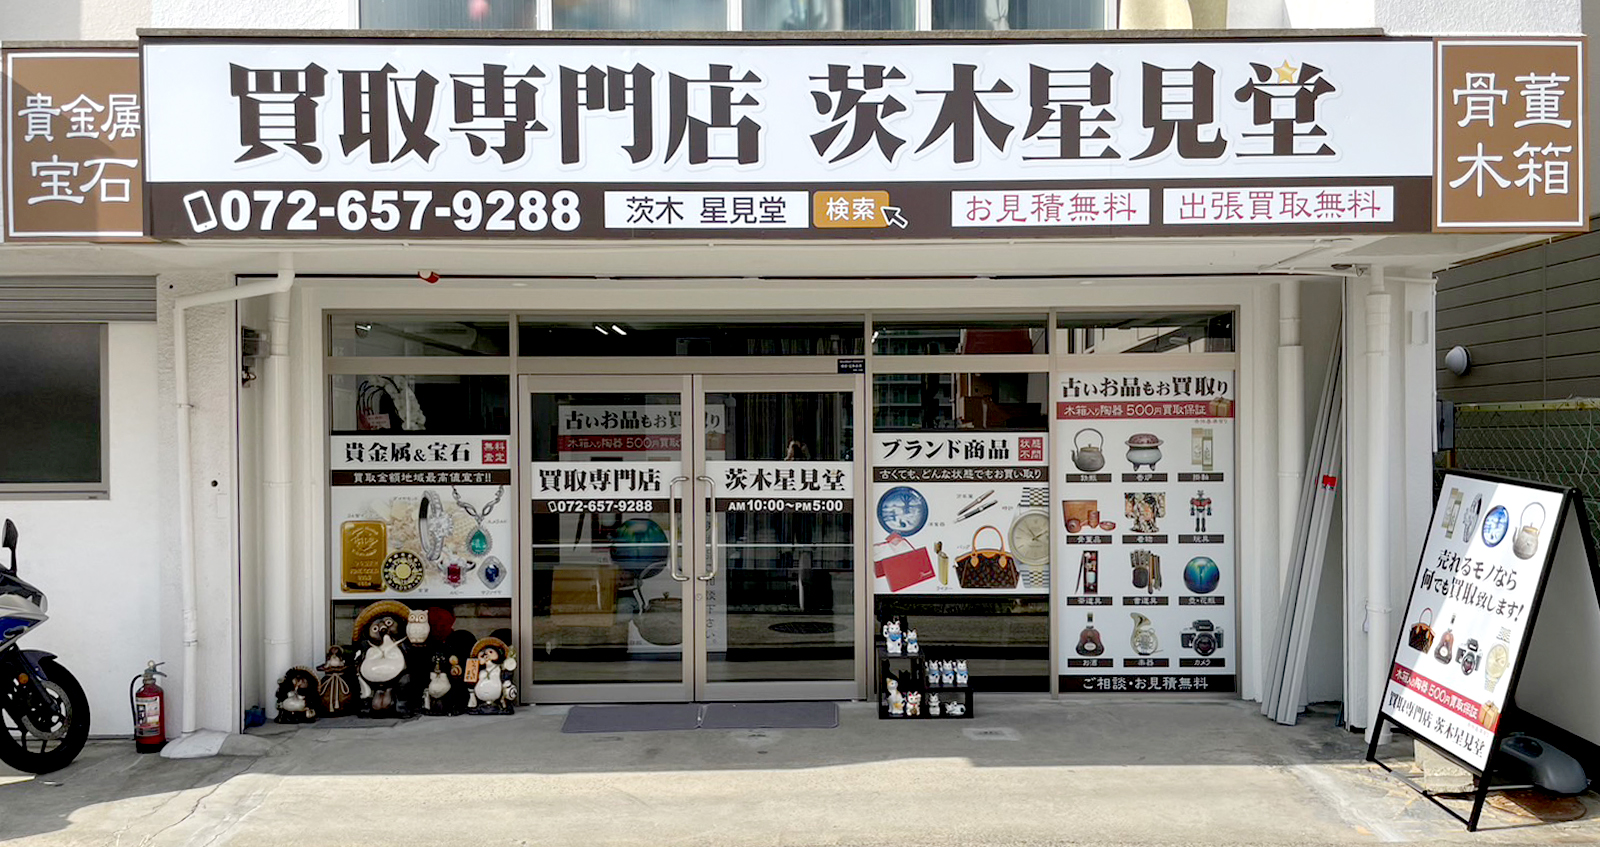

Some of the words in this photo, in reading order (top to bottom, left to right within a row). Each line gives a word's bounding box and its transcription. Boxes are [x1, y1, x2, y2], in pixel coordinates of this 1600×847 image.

[229, 62, 764, 166] 買取専門店
[808, 60, 1336, 163] 茨木星見堂
[1452, 71, 1573, 129] 骨董
[17, 91, 141, 142] 貴金属
[27, 153, 139, 206] 宝石
[1448, 141, 1574, 198] 木箱
[220, 191, 581, 233] 072-657-9288
[626, 196, 684, 225] 茨木
[699, 196, 787, 225] 星見堂
[825, 196, 877, 222] 検索
[965, 191, 1137, 224] お見積無料
[1179, 189, 1381, 222] 出張買取無料
[1061, 376, 1229, 398] 古いお品もお買取り
[565, 409, 721, 430] 古いお品もお買り
[345, 441, 471, 464] 貴金属&宝石
[881, 438, 1011, 461] ブランド商品
[539, 468, 662, 493] 買取専門店
[724, 467, 846, 492] 茨木星見堂
[557, 500, 654, 513] 072-657-9288
[1436, 549, 1518, 591] 売れるモノなら
[1420, 567, 1525, 622] 何でも買取致します!
[1193, 657, 1211, 667] カメラ
[1083, 677, 1208, 691] ご相談・お見積無料
